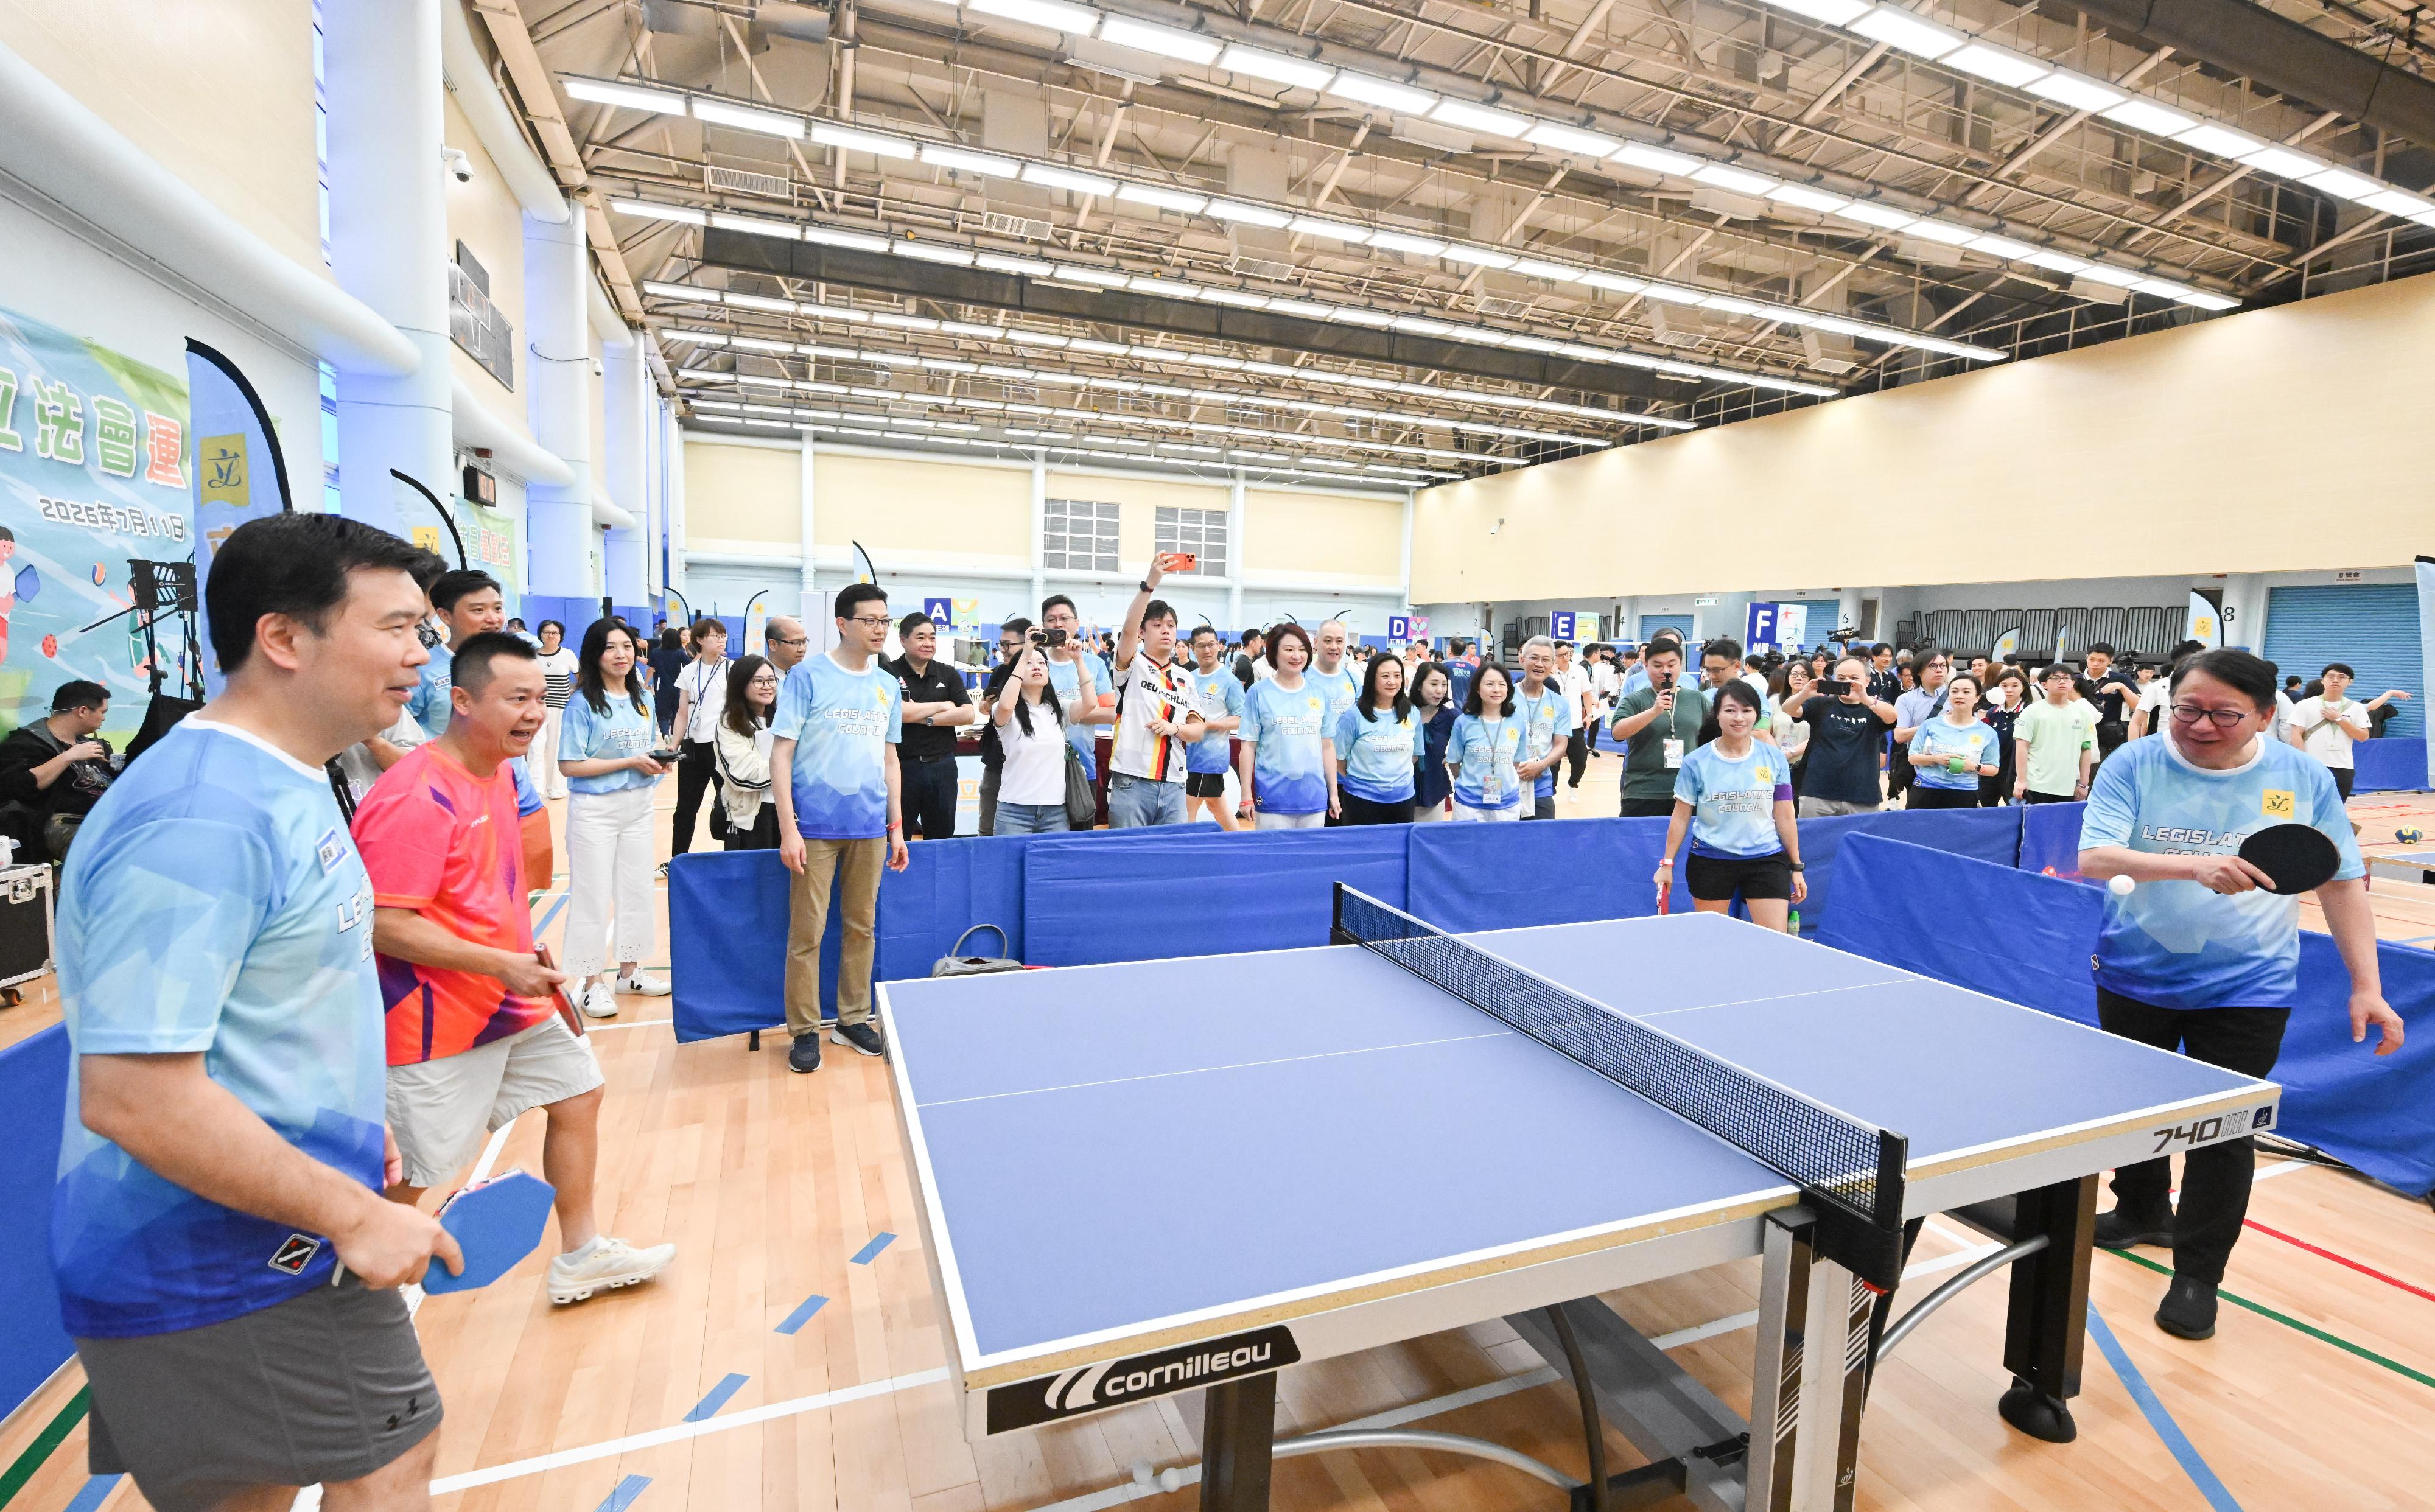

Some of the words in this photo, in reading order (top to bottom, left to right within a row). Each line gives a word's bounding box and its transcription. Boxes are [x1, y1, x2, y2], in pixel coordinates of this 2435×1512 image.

[38, 495, 186, 542] 2026年7月11日
[929, 602, 948, 622] A
[1842, 613, 1849, 624] 6
[2223, 607, 2235, 621] 8
[1393, 619, 1405, 637] D
[1557, 616, 1571, 637] E
[1620, 617, 1625, 625] 4
[1756, 610, 1773, 639] F
[936, 625, 950, 634] 毛球
[838, 723, 881, 737] COUNCIL
[1281, 726, 1316, 735] COUNCIL
[1705, 789, 1774, 802] LEGISLATIVE
[1717, 802, 1762, 814] COUNCIL
[2141, 825, 2253, 847] LEGISLAT
[2153, 1116, 2223, 1153] 740
[1105, 1342, 1272, 1396] cornilleau
